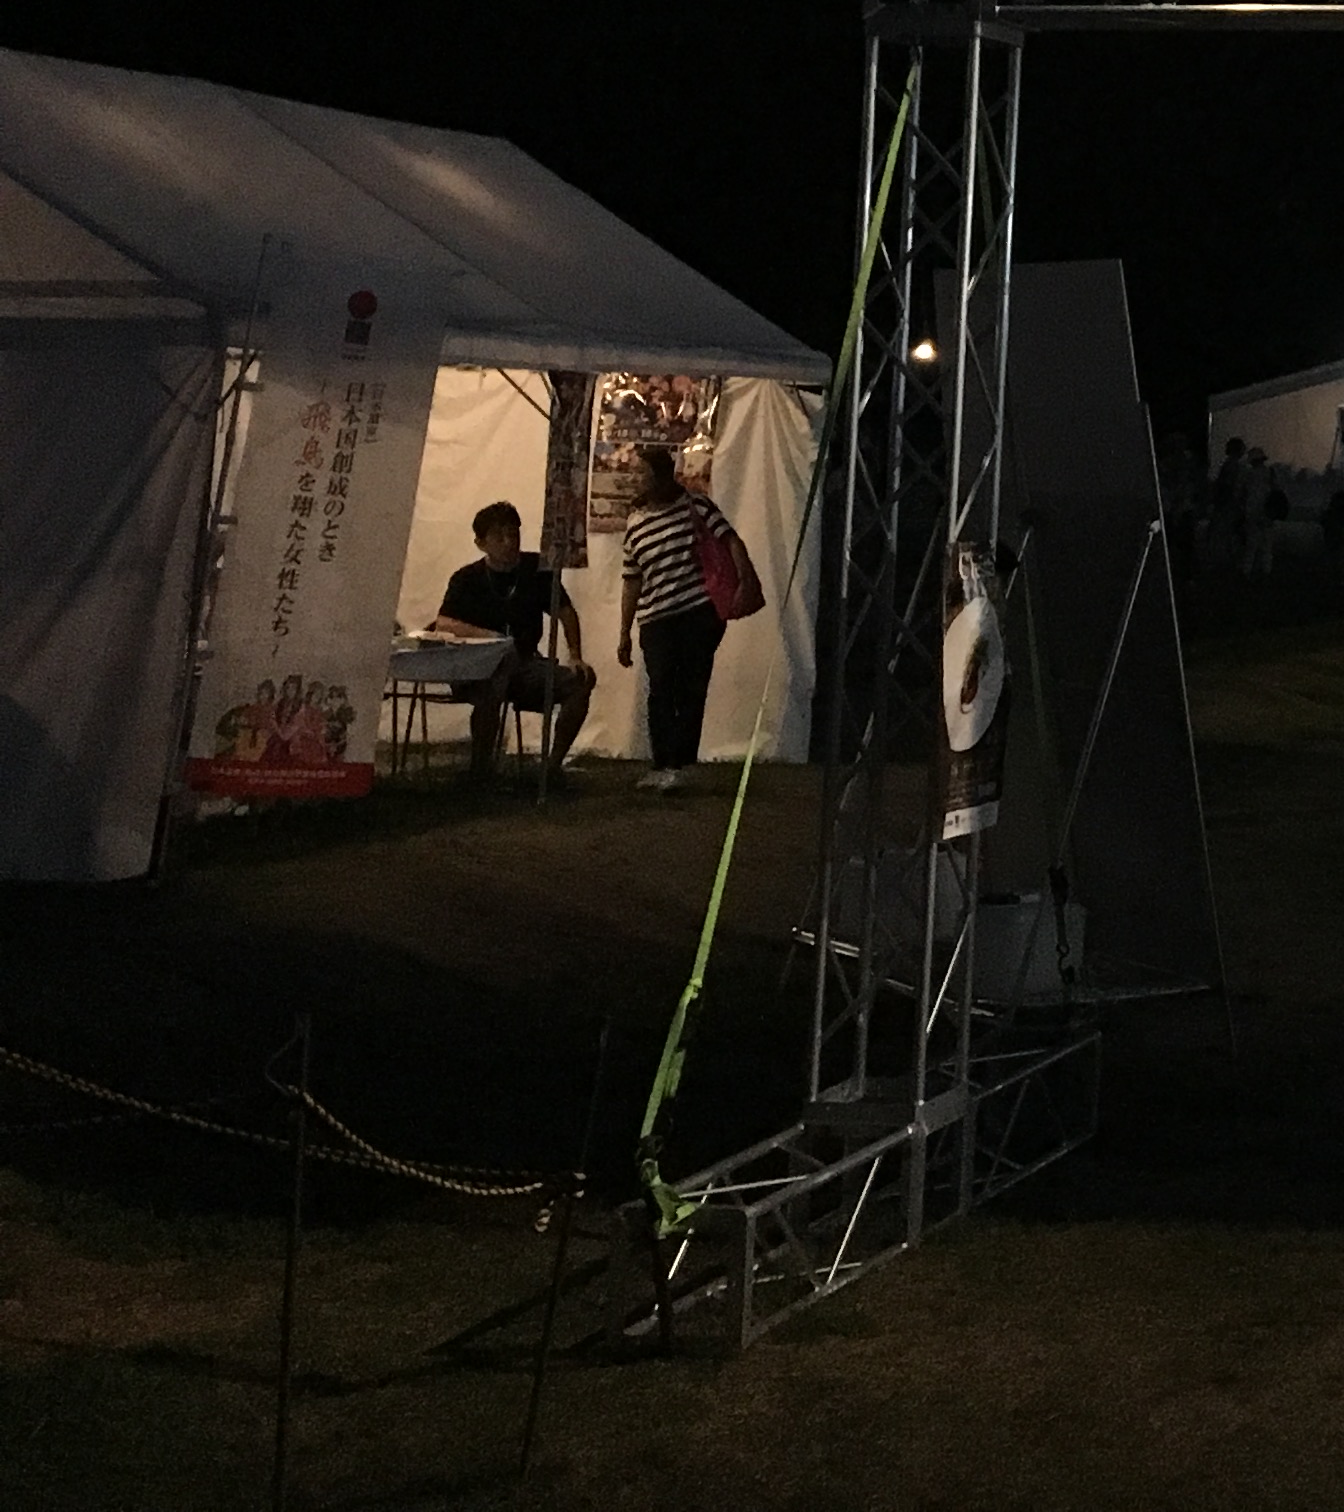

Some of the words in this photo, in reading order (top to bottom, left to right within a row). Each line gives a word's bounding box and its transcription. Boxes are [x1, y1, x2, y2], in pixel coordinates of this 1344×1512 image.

[318, 383, 366, 563] 日本国創成のとき
